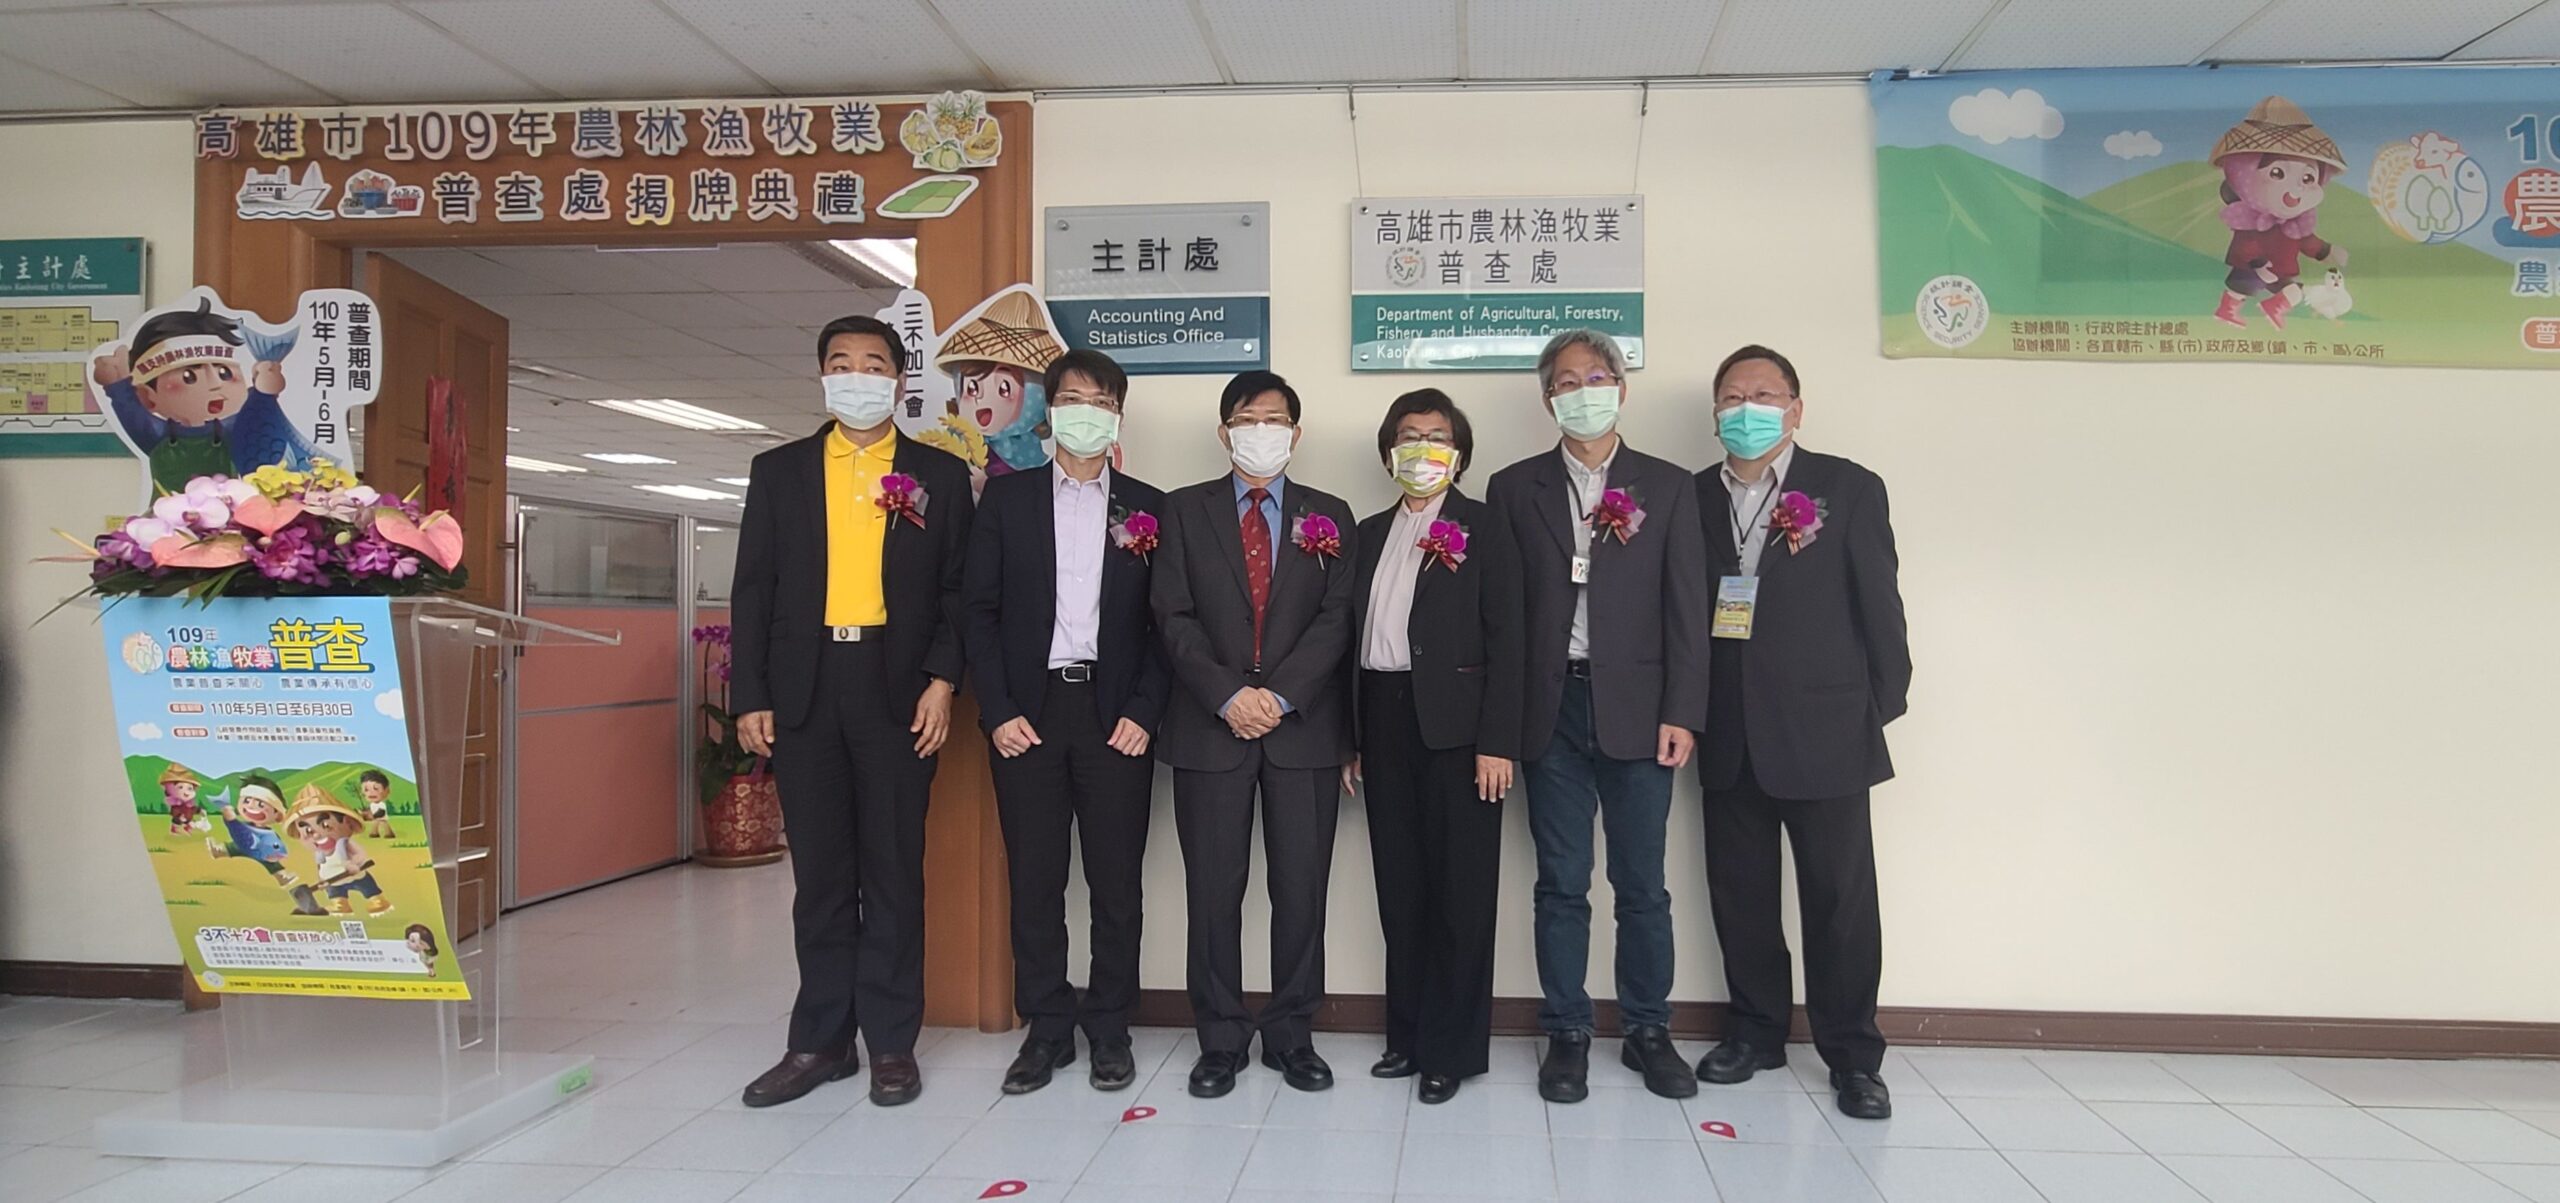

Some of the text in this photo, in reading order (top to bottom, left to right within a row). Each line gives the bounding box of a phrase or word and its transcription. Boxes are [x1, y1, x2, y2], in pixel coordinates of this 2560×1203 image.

[199, 102, 878, 154] 高雄市109年農林漁牧業
[436, 171, 859, 219] 普查處揭牌典禮
[1376, 207, 1621, 245] 高雄市農林漁牧業
[0, 254, 92, 280] 主計處
[1092, 236, 1219, 273] 主計處
[1438, 249, 1558, 285] 普查處
[1088, 306, 1224, 326] Accounting And
[1377, 304, 1623, 323] Department of Agricultural, Forestry,
[347, 302, 371, 391] 普查期間
[1088, 329, 1224, 345] Statistics Office
[1377, 326, 1423, 340] Fishery
[1431, 325, 1455, 338] and
[1463, 324, 1532, 339] Husbandry
[309, 301, 339, 444] 110年5月-6月
[903, 303, 924, 417] 三不加二會
[167, 627, 218, 643] 109年
[269, 617, 369, 672] 普查
[211, 702, 352, 716] 110年5月1日至6月30日
